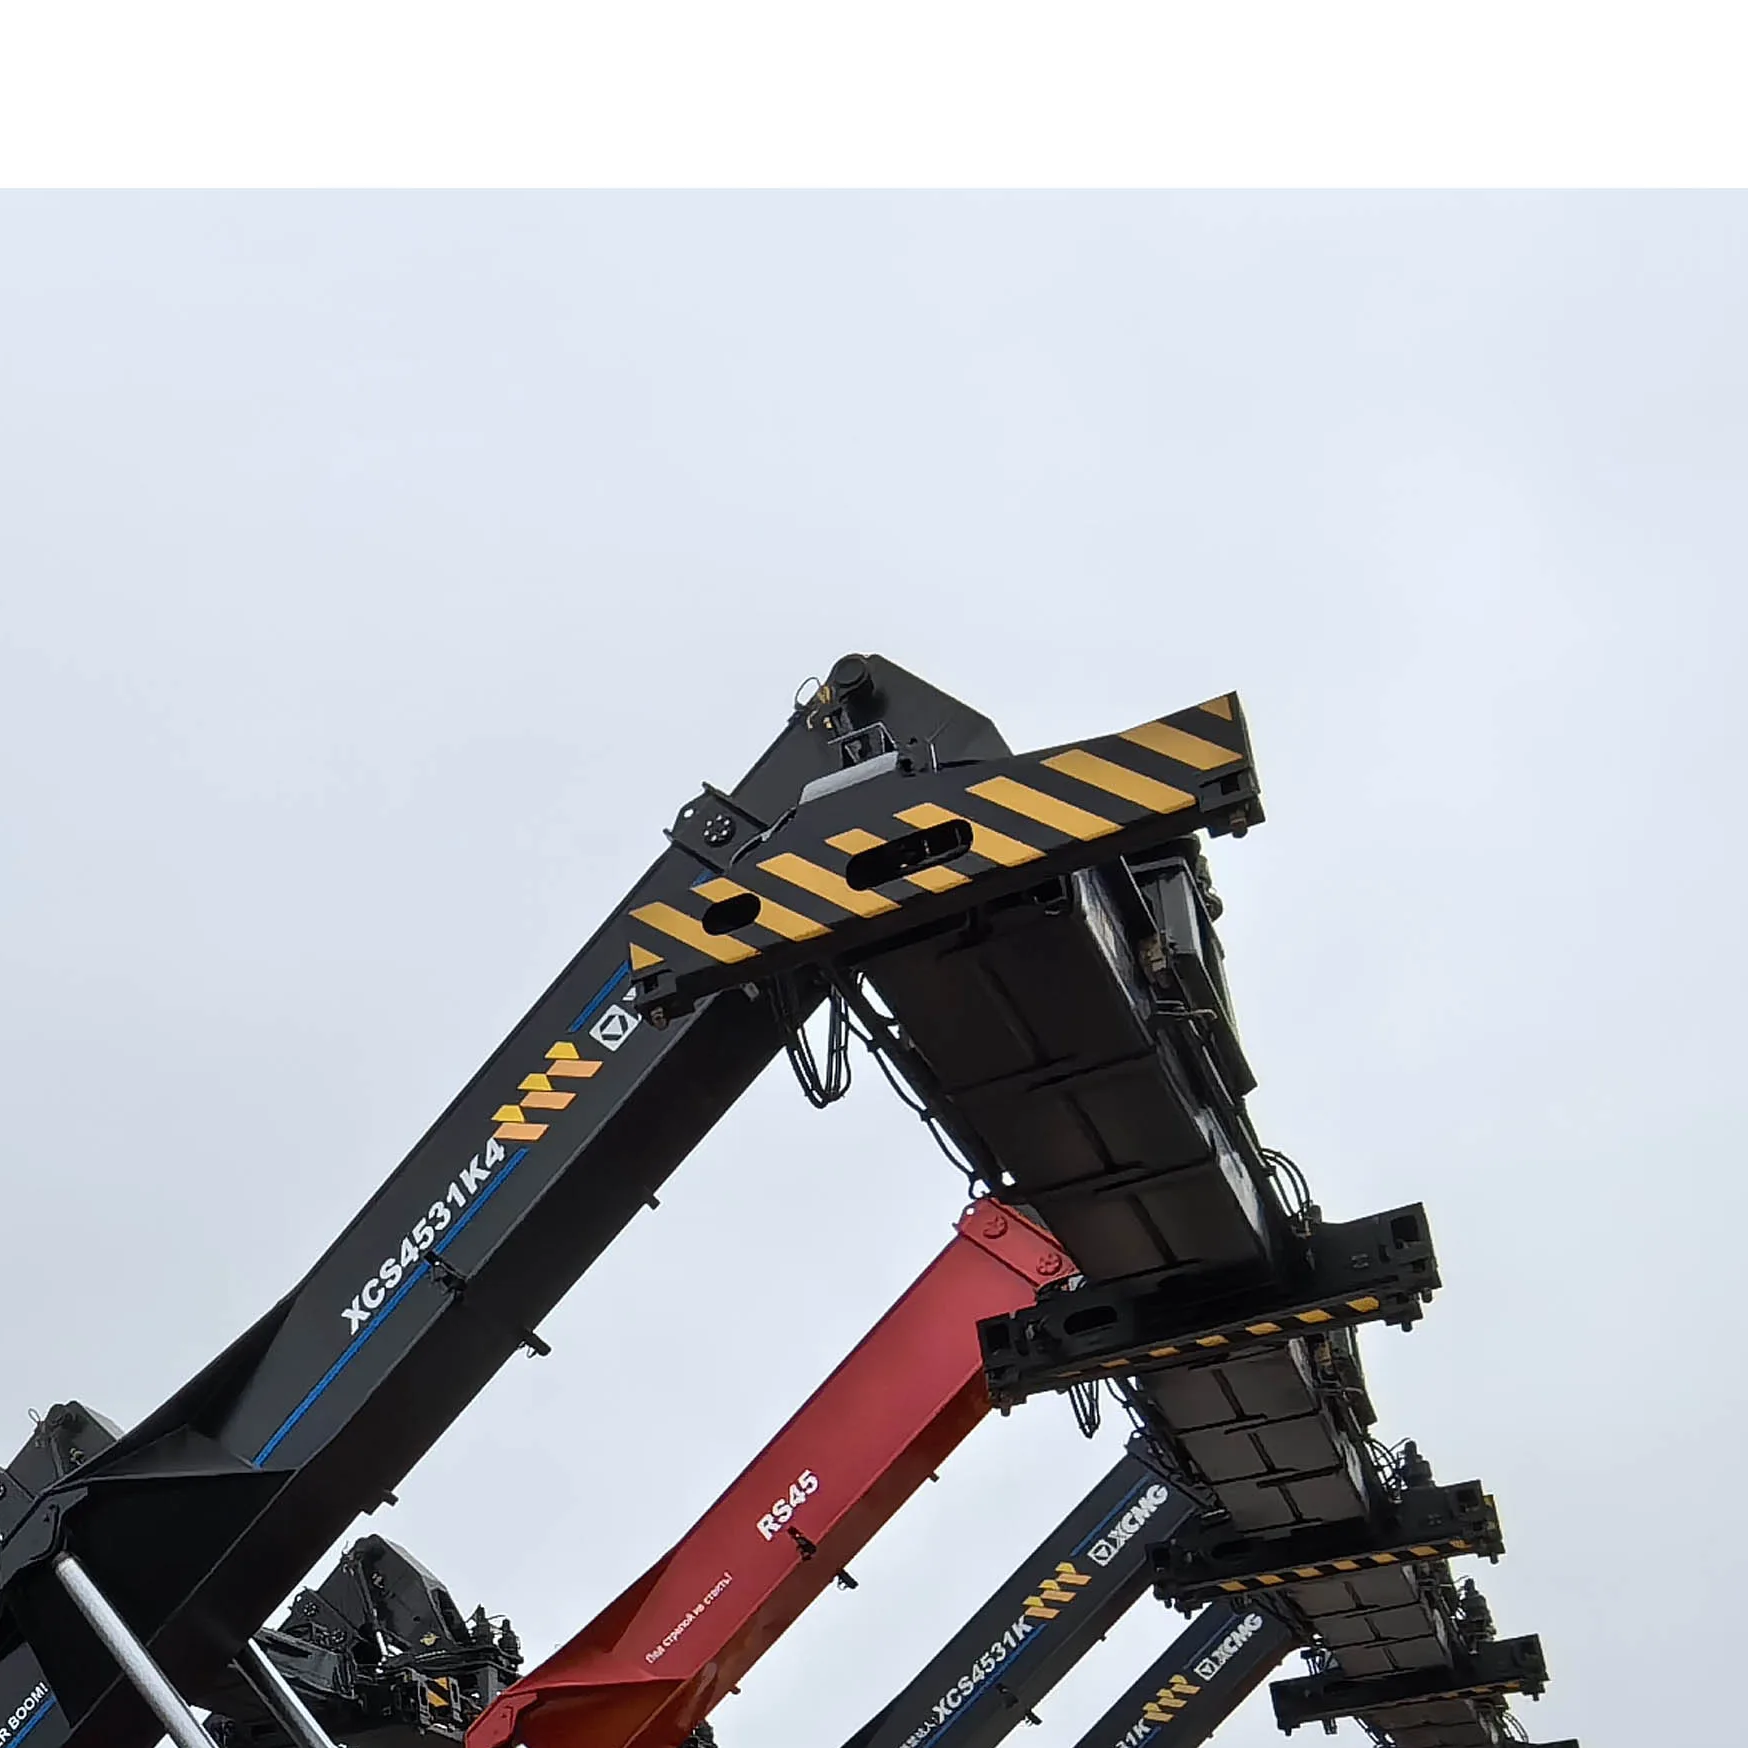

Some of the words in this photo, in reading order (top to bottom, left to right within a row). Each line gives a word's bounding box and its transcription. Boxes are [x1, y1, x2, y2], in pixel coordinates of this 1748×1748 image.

[341, 1136, 504, 1335] XCS4531K4
[756, 1469, 819, 1541] RS45
[1107, 1484, 1169, 1551] XCMG
[932, 1615, 1034, 1724] XCS4531K
[1211, 1613, 1264, 1666] XCMG
[7, 1682, 50, 1730] BOOM!
